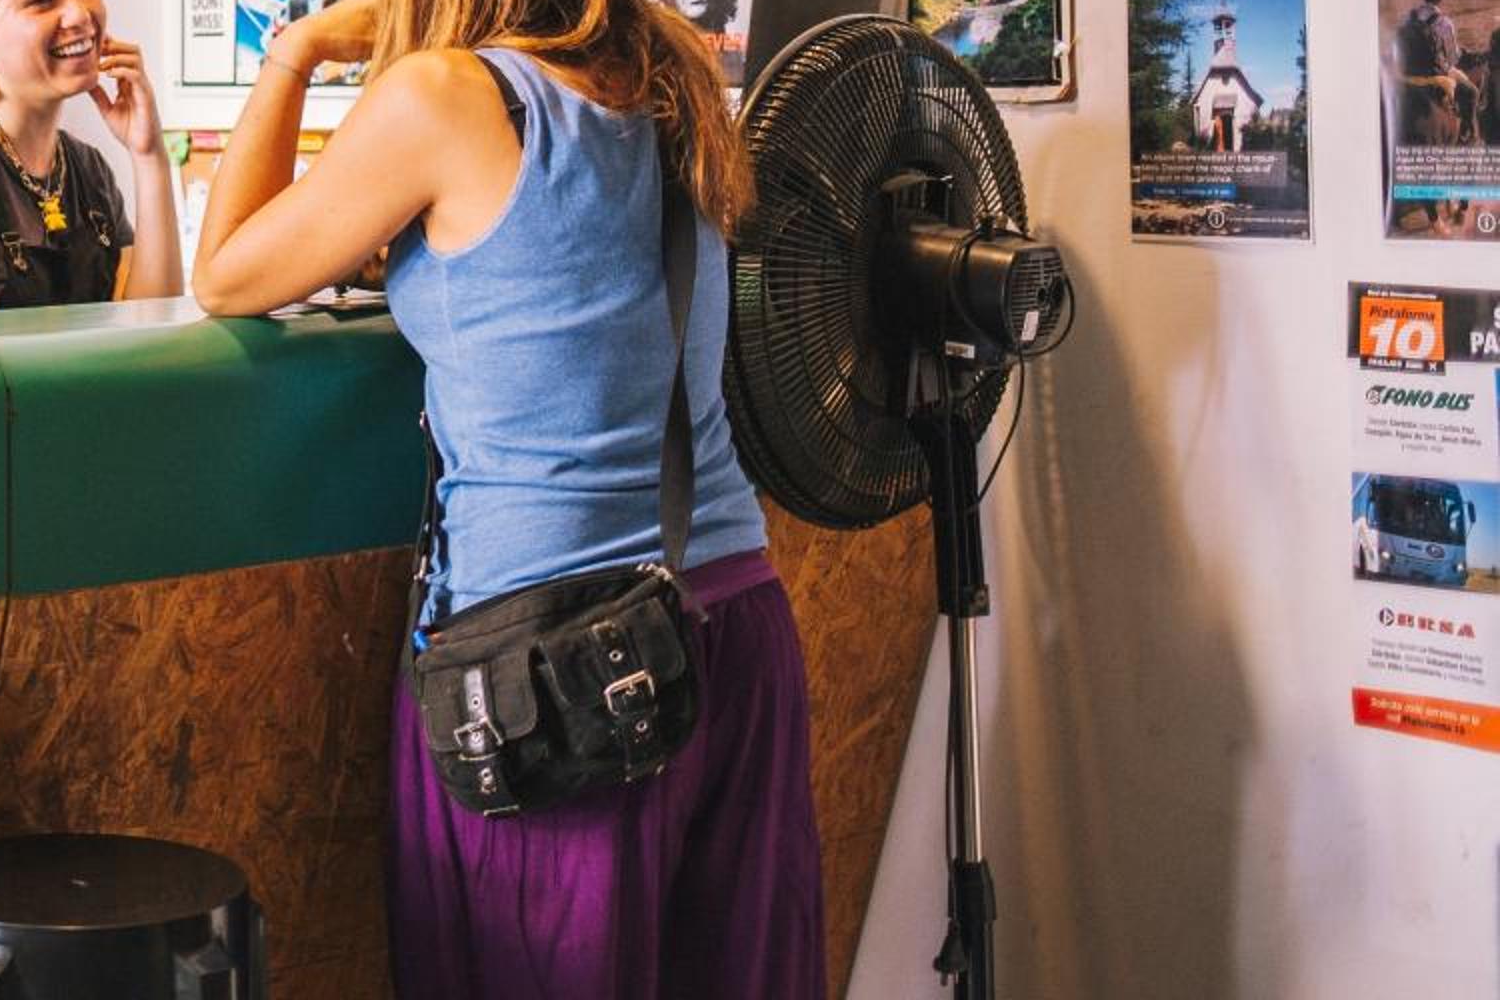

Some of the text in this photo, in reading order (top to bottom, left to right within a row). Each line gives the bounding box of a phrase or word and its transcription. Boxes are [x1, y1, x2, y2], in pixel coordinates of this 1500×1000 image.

[1369, 305, 1435, 322] Plataforma
[1368, 317, 1436, 360] 10
[1381, 387, 1475, 411] FONO BUS
